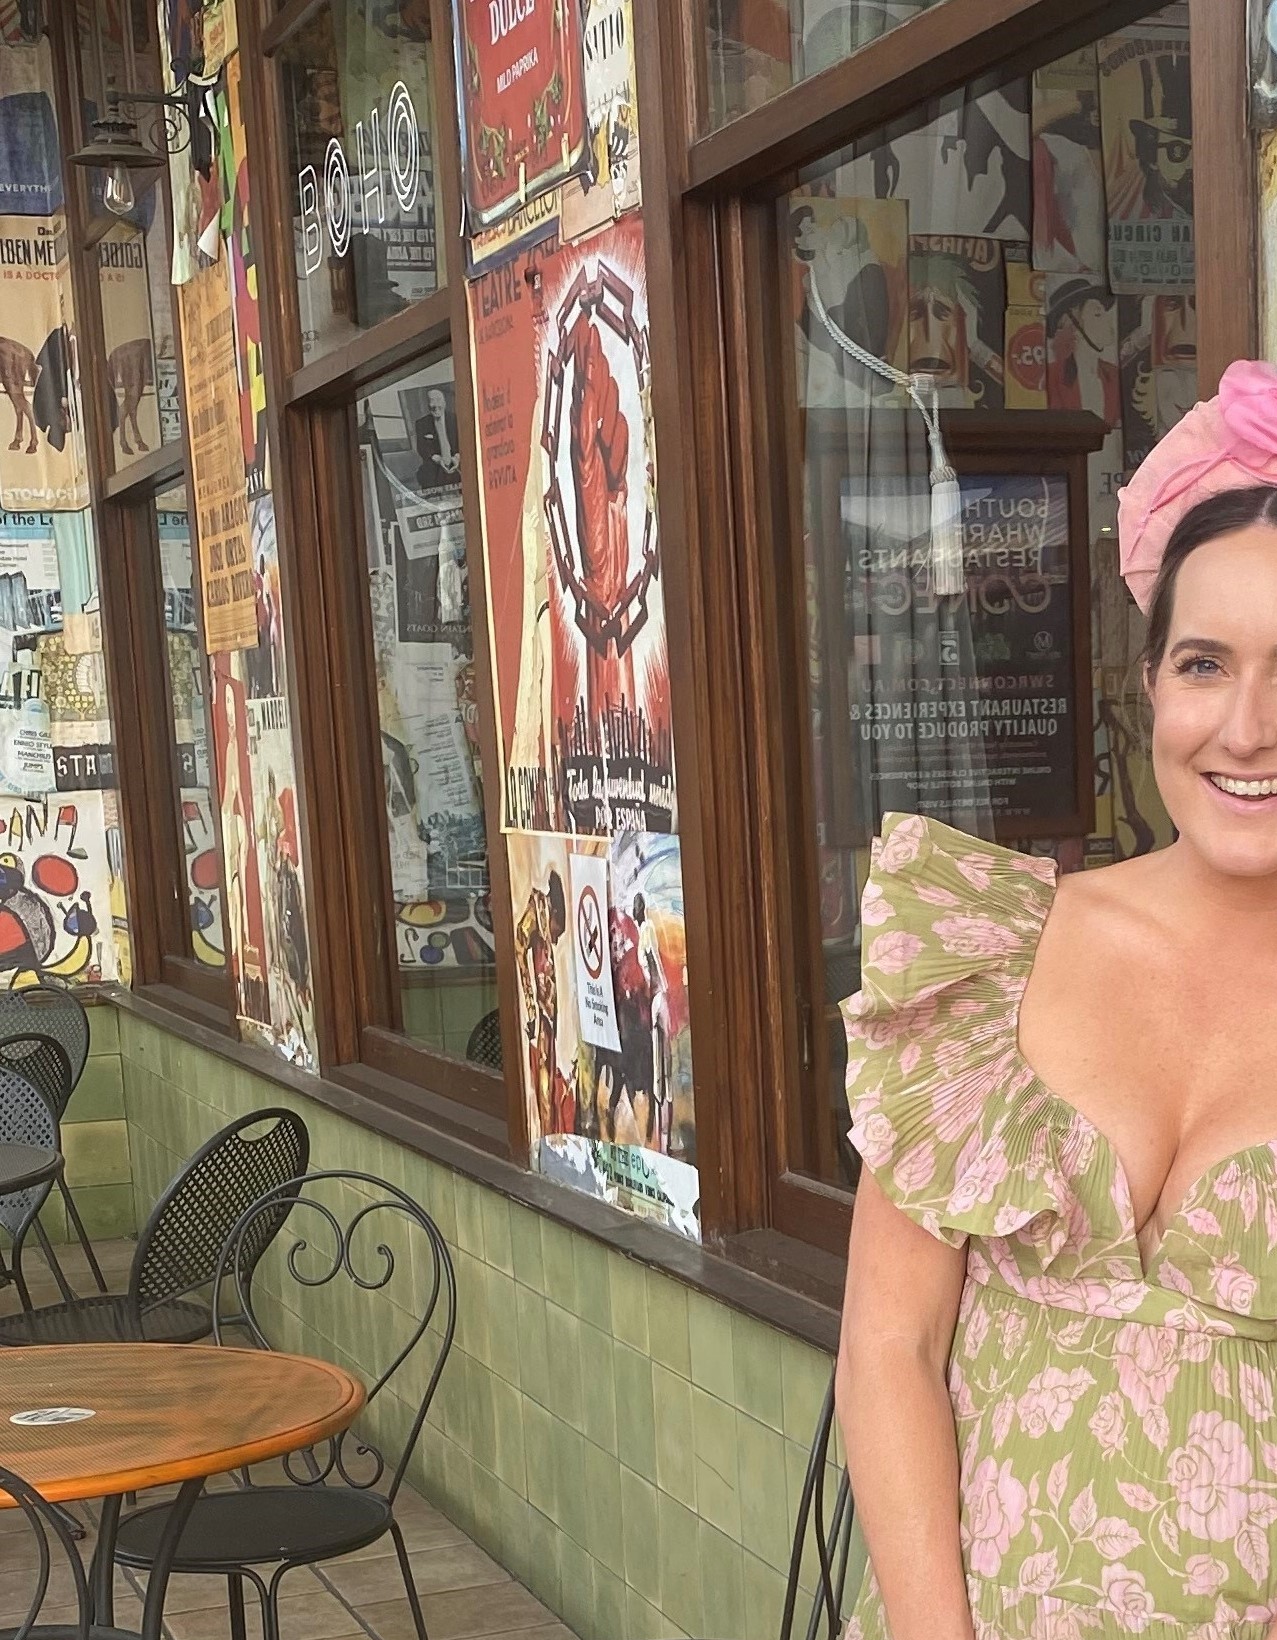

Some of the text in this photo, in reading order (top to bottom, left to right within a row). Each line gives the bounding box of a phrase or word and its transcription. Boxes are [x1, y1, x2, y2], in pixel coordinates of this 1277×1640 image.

[511, 47, 539, 83] PAPRIKA
[298, 80, 419, 276] BOHO
[12, 512, 36, 526] the
